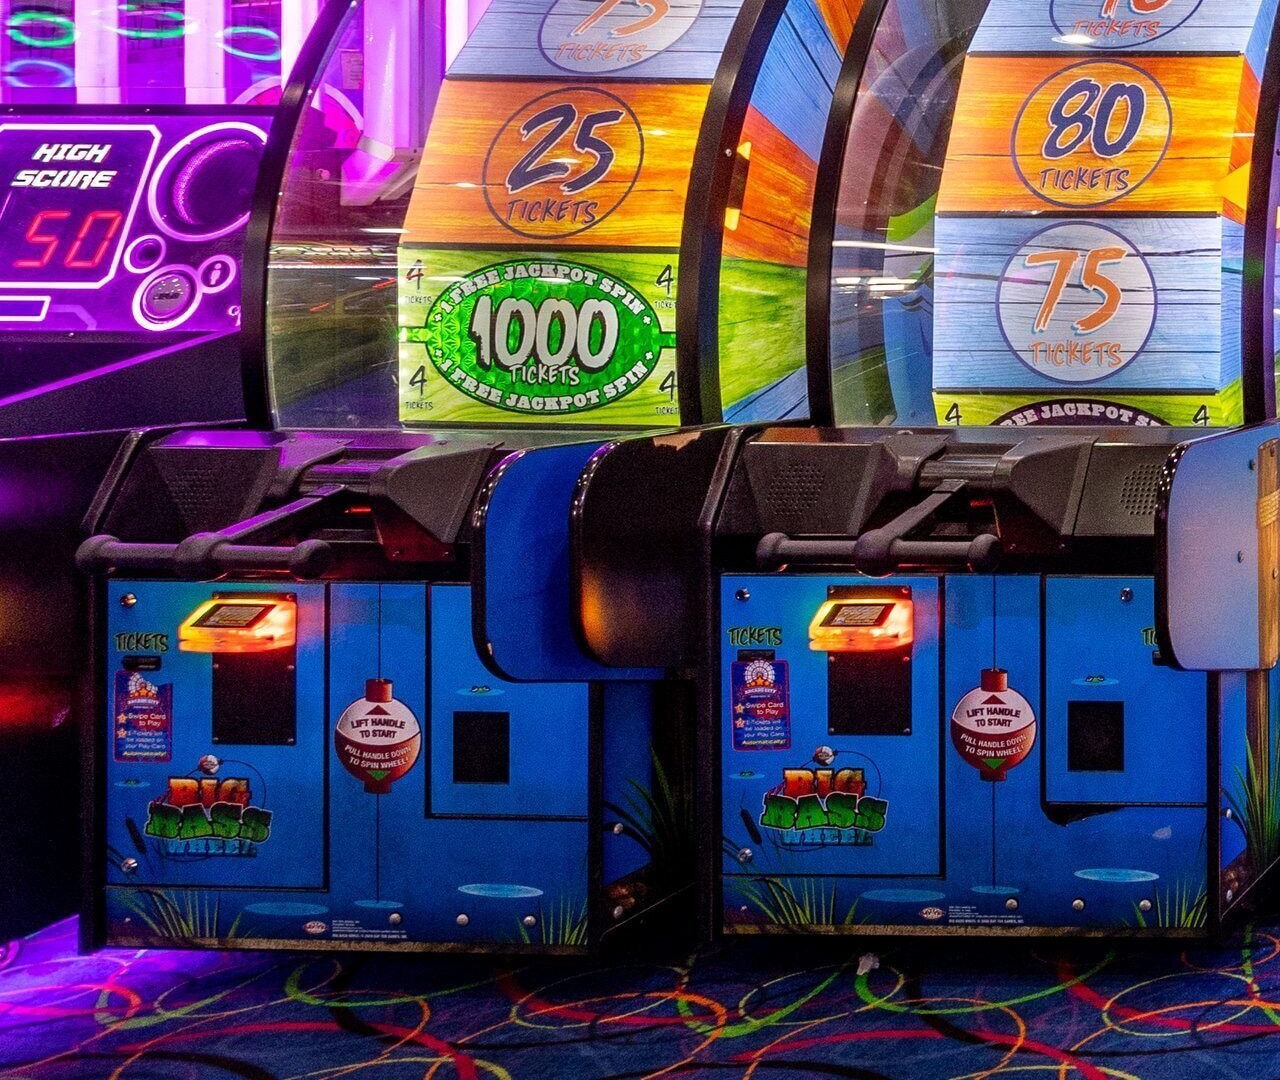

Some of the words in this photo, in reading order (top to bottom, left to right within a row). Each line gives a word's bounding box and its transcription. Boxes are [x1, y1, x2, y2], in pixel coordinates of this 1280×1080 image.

[1070, 17, 1161, 37] TICKETS
[555, 42, 648, 63] TICKETS
[1043, 77, 1147, 160] 80
[31, 143, 112, 163] HIGH
[507, 103, 626, 195] 25
[11, 169, 117, 190] SCORE
[1038, 167, 1131, 192] TICKETS
[507, 198, 599, 225] TICKETS
[13, 210, 124, 268] 50
[406, 259, 425, 290] 4
[656, 264, 674, 296] 4
[404, 295, 432, 304] TICKETS
[449, 270, 501, 301] FREE
[504, 263, 598, 286] JACKPOT
[598, 277, 645, 315] SPIN
[1026, 246, 1128, 335] 75
[471, 294, 619, 370] 1000
[1028, 341, 1123, 368] TICKETS
[408, 365, 427, 396] 4
[450, 368, 502, 406] FREE
[505, 390, 600, 412] JACKPOT
[603, 360, 649, 399] SPIN
[509, 363, 580, 385] TICKETS
[658, 370, 678, 402] 4
[405, 401, 434, 410] TICKETS
[944, 402, 964, 426] 4
[1044, 402, 1131, 420] JACKPOT
[1191, 402, 1210, 426] 4
[115, 632, 169, 652] TICKETS
[728, 626, 783, 646] TICKETS
[351, 719, 369, 729] LIFT
[371, 718, 406, 729] HANDLE
[966, 708, 985, 718] LIFT
[987, 707, 1021, 718] HANDLE
[975, 719, 986, 727] TO
[988, 718, 1012, 727] START
[359, 730, 370, 738] TO
[372, 729, 397, 738] START
[960, 733, 976, 745] PULL
[978, 740, 1005, 748] HANDLE
[1006, 734, 1026, 746] DOWN
[345, 745, 361, 756] PULL
[362, 752, 390, 760] HANDLE
[349, 757, 359, 766] TO
[361, 760, 379, 768] SPIN
[965, 745, 976, 753] TO
[976, 748, 995, 757] SPIN
[996, 746, 1024, 757] WHEEL!
[168, 776, 252, 808] BIG
[783, 767, 867, 799] BIG
[144, 801, 273, 845] BASS
[759, 791, 889, 833] BASS
